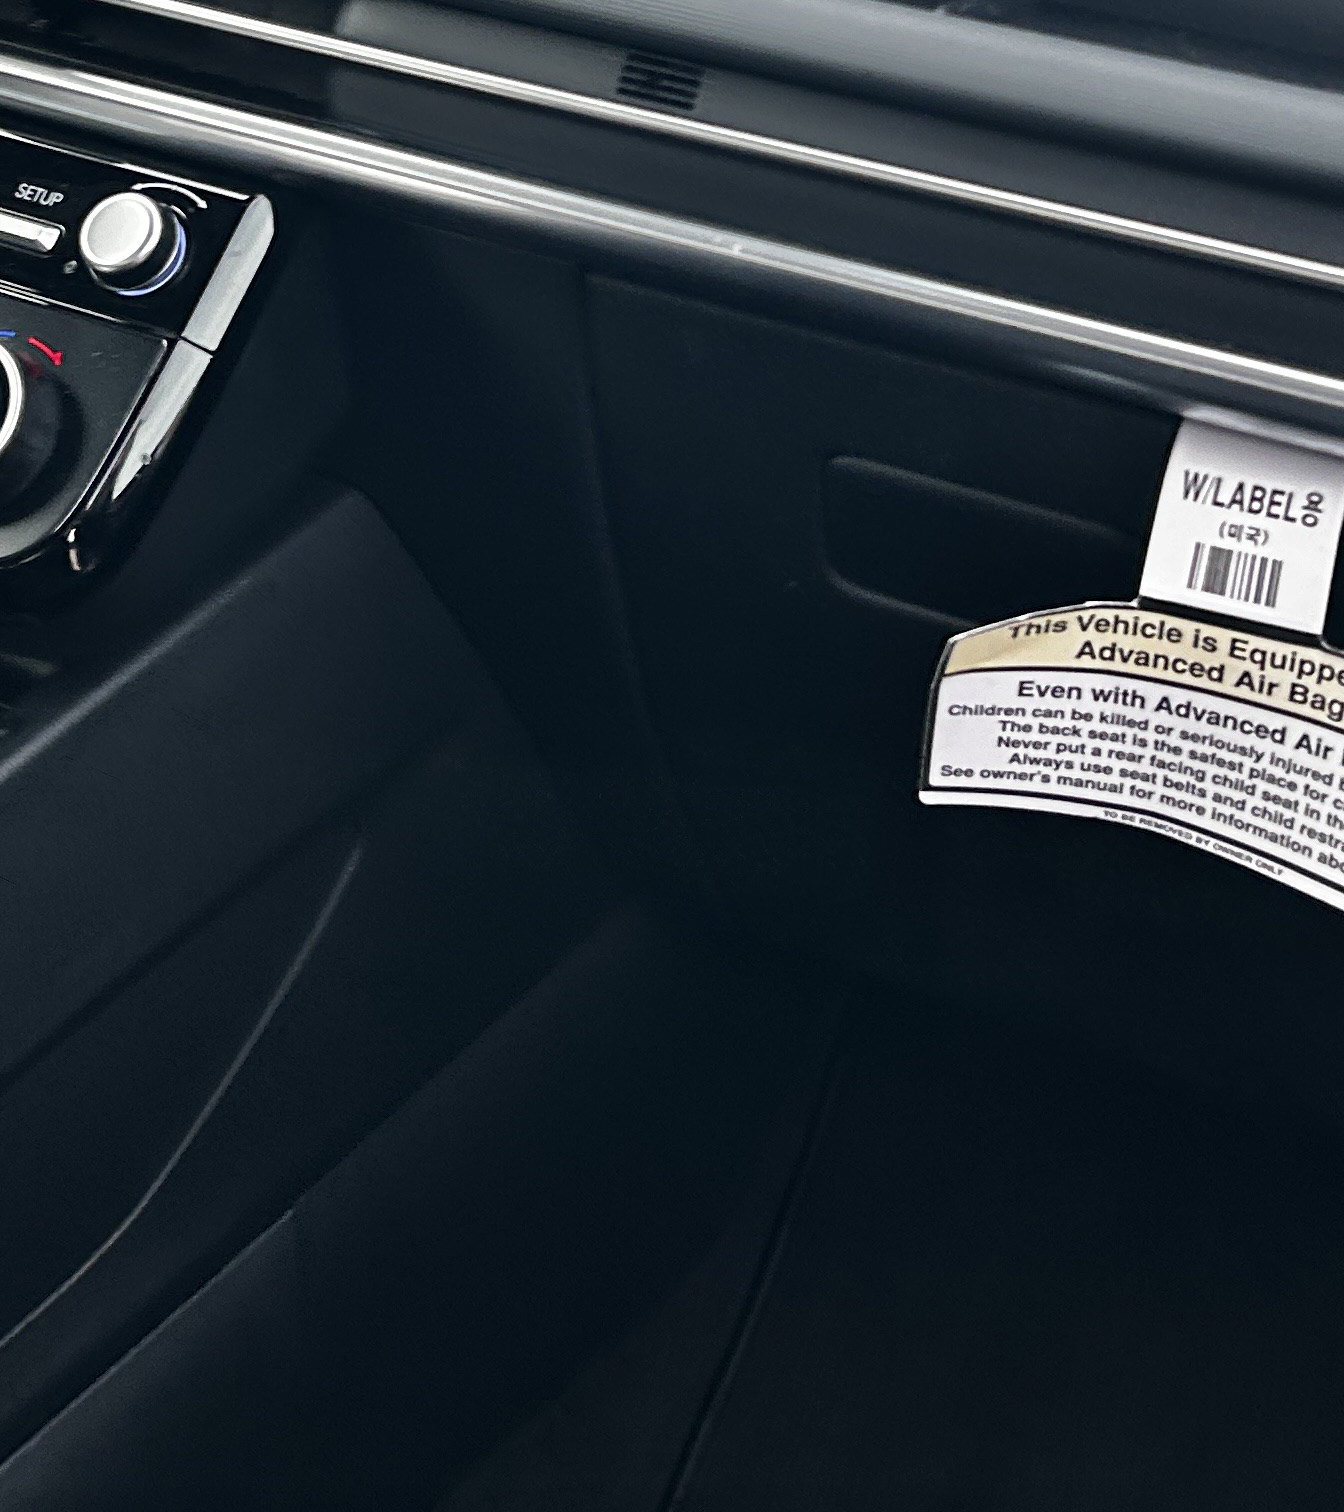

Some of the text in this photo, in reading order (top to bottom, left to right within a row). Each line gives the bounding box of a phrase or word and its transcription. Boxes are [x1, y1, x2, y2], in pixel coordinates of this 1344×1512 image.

[14, 183, 64, 207] SETUP
[1009, 618, 1068, 639] This
[1076, 614, 1182, 643] Vehicle
[1192, 629, 1218, 653] is
[1075, 639, 1225, 684] Advanced
[1235, 670, 1280, 697] Air
[947, 704, 1026, 717] Children
[1032, 707, 1065, 720] can
[1071, 708, 1094, 723] be
[1099, 711, 1149, 732] killed
[1154, 724, 1174, 737] or
[1179, 729, 1265, 764] seriously
[1269, 751, 1334, 787] injured
[1017, 680, 1082, 700] Even
[1091, 686, 1146, 709] with
[1154, 696, 1287, 745] Advanced
[1294, 733, 1335, 761] Air
[997, 736, 1051, 751] Never
[1056, 740, 1086, 755] put
[1091, 747, 1102, 757] a
[1107, 748, 1145, 764] rear
[1149, 754, 1206, 782] facing
[1211, 773, 1258, 797] child
[1261, 790, 1300, 813] seat
[1305, 803, 1322, 821] in
[998, 720, 1033, 734] The
[1038, 721, 1083, 738] back
[1087, 728, 1127, 745] seat
[1132, 734, 1148, 748] is
[1153, 740, 1183, 756] the
[1188, 749, 1244, 774] safest
[1248, 766, 1298, 792] place
[1303, 783, 1329, 803] for
[1008, 752, 1074, 772] Always
[1080, 761, 1113, 776] use
[1119, 766, 1157, 785] seat
[1162, 775, 1207, 799] belts
[1211, 791, 1247, 811] and
[1250, 803, 1296, 831] child
[940, 764, 974, 778] See
[979, 769, 1052, 784] owner's
[1056, 774, 1124, 795] manual
[1129, 784, 1156, 801] for
[1159, 793, 1206, 817] more
[1210, 806, 1314, 859] information
[1103, 809, 1119, 819] TO
[1121, 813, 1136, 823] BE
[1195, 836, 1210, 847] BY
